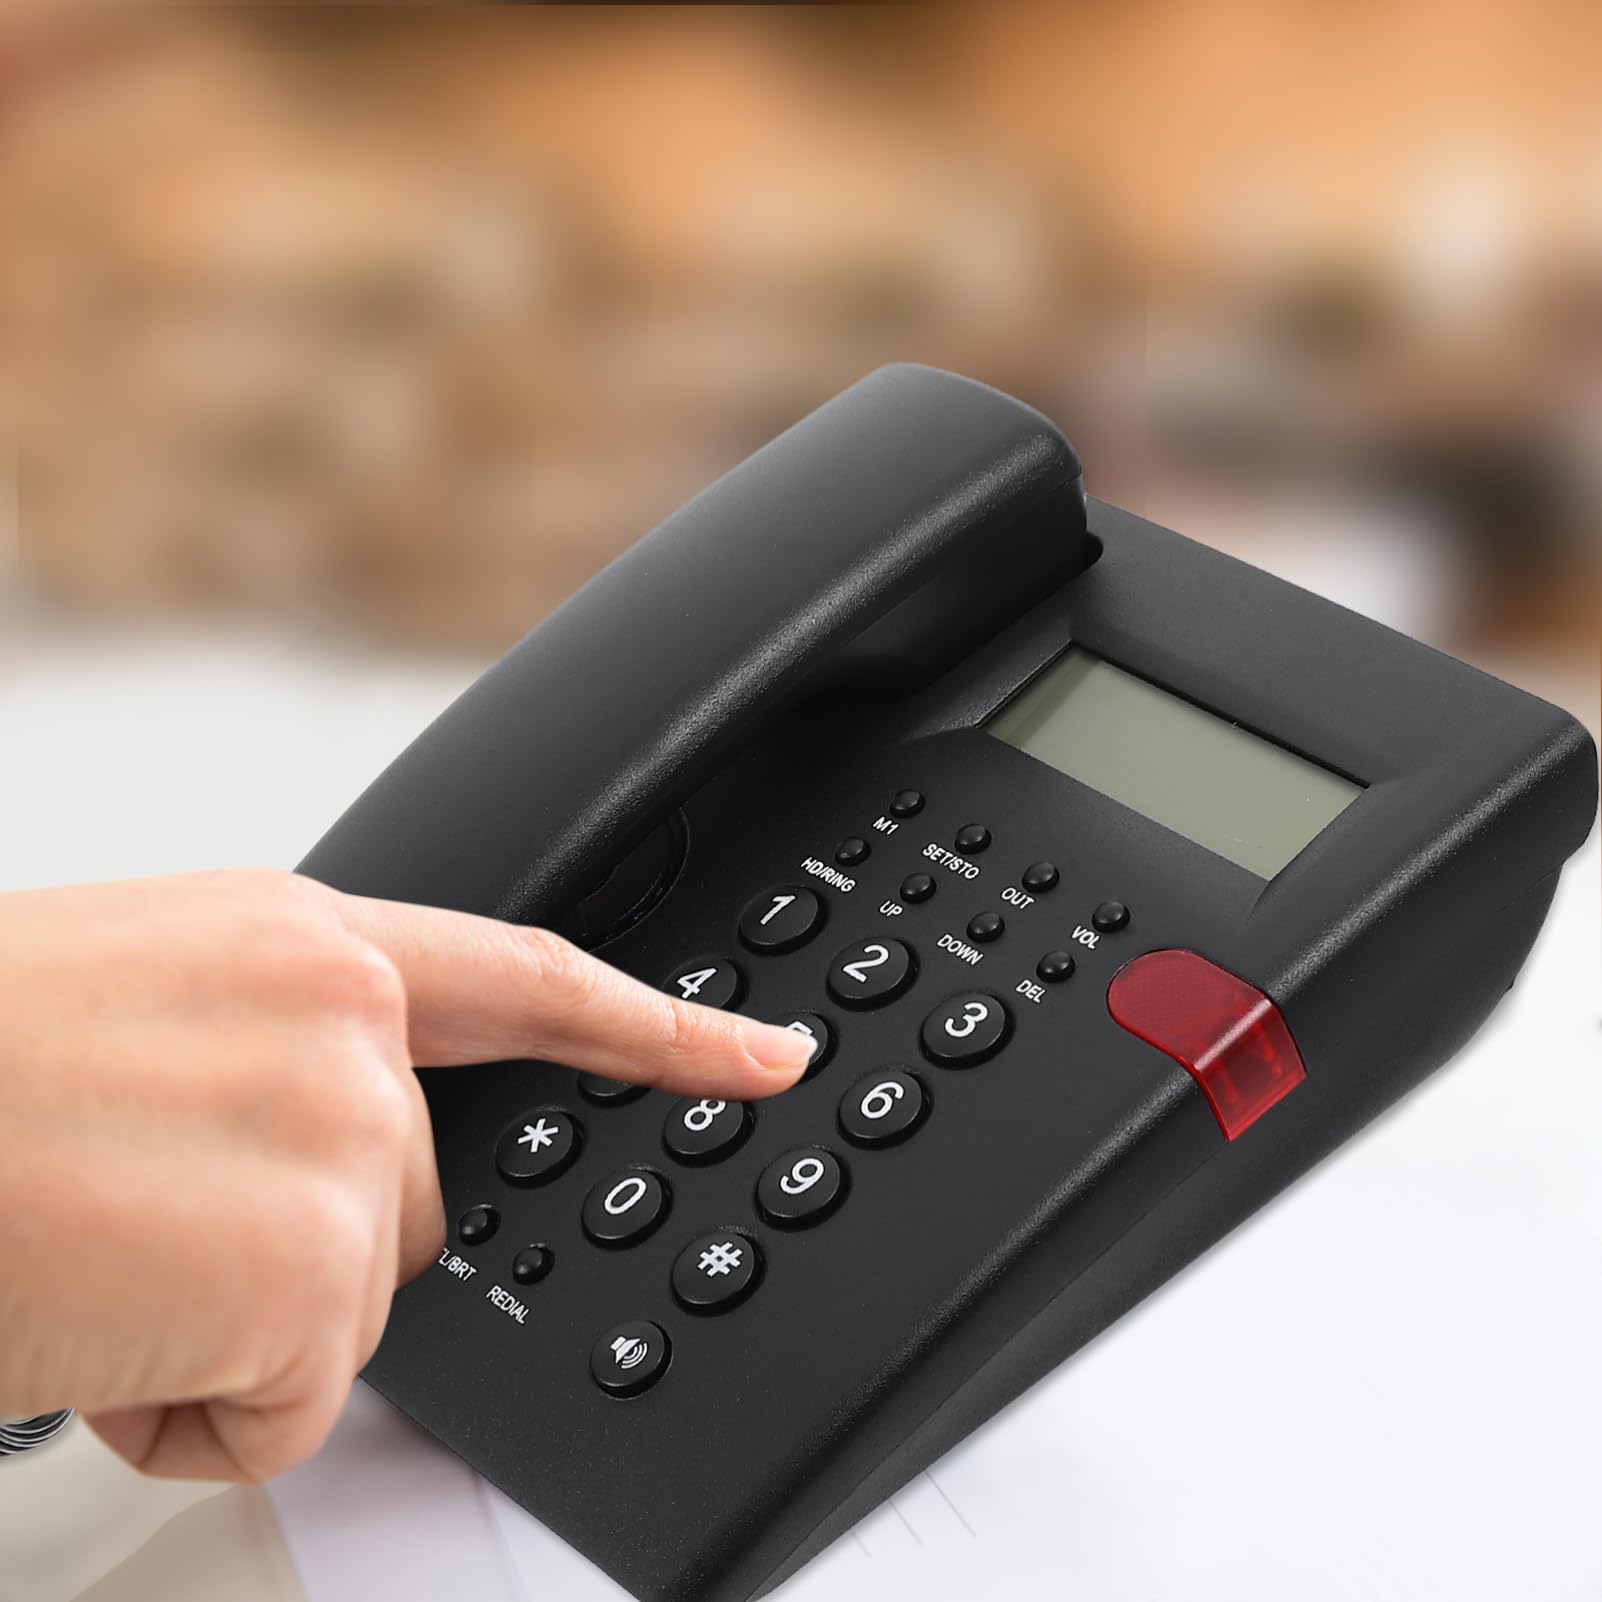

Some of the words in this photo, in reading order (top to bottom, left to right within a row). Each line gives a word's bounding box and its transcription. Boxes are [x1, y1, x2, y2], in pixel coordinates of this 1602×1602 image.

[873, 817, 899, 835] M1
[801, 857, 856, 892] HD/RING
[923, 842, 981, 880] SET/STO
[761, 895, 795, 925] 1
[879, 900, 902, 917] UP
[1001, 888, 1034, 910] OUT
[937, 933, 983, 965] DOWN
[1071, 925, 1099, 949] VOL
[842, 944, 888, 983] 2
[676, 967, 716, 1001] 4
[1015, 979, 1045, 1003] DEL
[945, 1002, 987, 1037] 3
[683, 1099, 725, 1132] 8
[860, 1081, 903, 1118] 6
[781, 1157, 824, 1195] 9
[604, 1177, 646, 1215] 0
[438, 1247, 477, 1281] L/BRT
[697, 1241, 742, 1277] #
[485, 1285, 530, 1324] REDIAL
